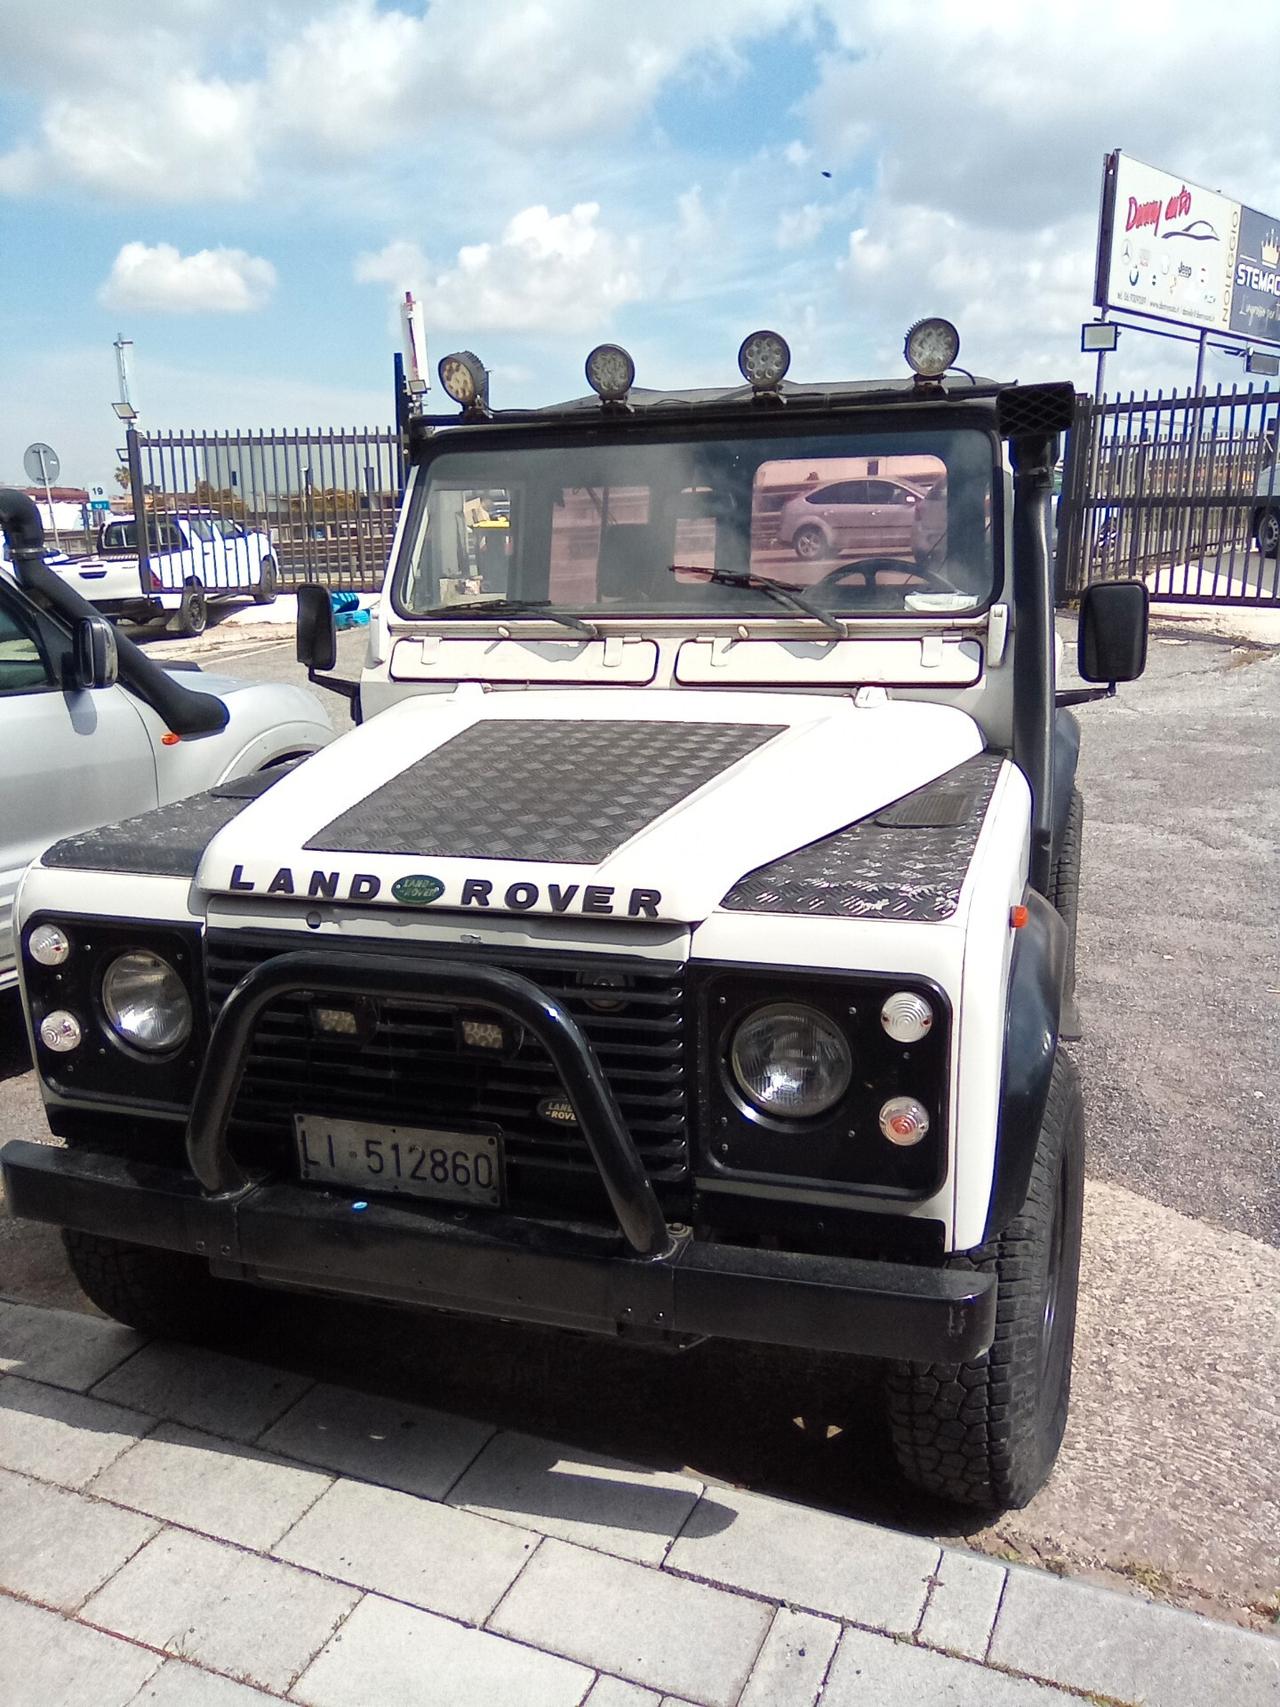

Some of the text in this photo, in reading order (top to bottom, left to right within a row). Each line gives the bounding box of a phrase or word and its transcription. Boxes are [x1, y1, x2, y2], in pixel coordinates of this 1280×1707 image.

[1222, 211, 1239, 322] NOLEGGIO
[92, 486, 104, 495] 19
[229, 864, 662, 918] LAND ROVER
[300, 1129, 495, 1189] LI 512860
